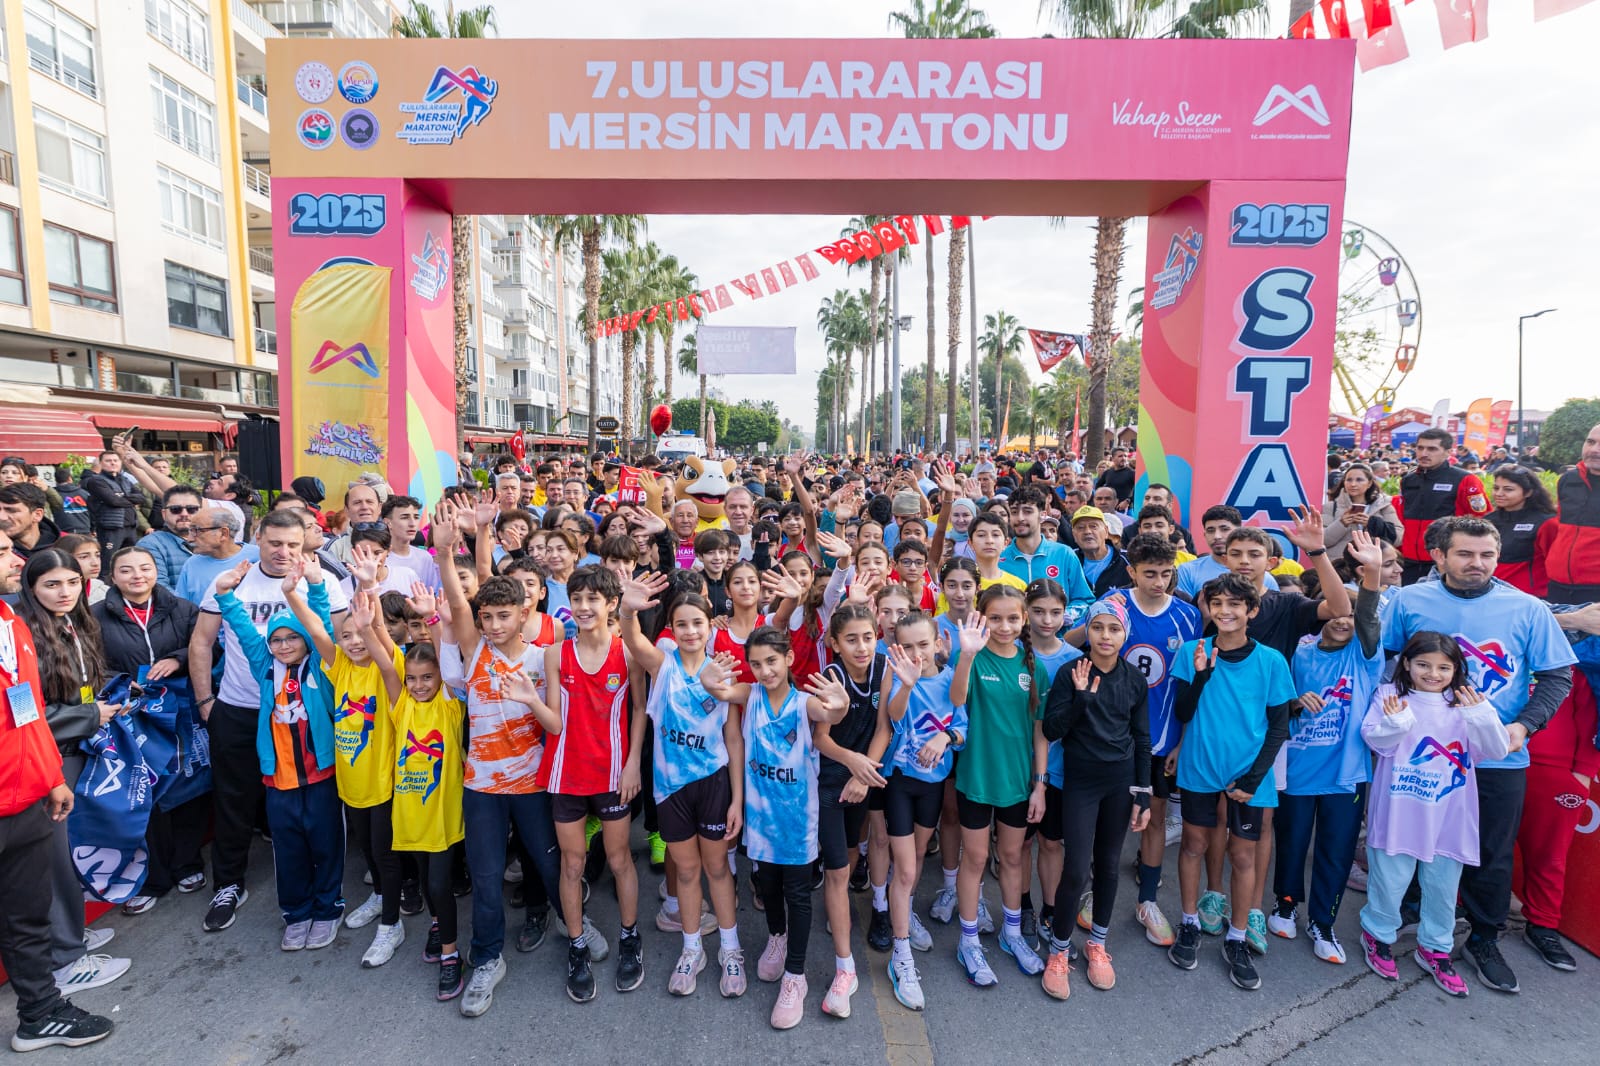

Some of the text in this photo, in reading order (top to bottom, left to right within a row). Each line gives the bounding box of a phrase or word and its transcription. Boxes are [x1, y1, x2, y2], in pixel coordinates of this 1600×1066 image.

[586, 61, 1042, 99] 7.ULUSLARARASI
[405, 124, 455, 132] MARATONU
[416, 111, 458, 122] MERSİN
[549, 100, 1068, 151] MERSİN MARATONU
[1112, 98, 1222, 138] Vahap Seçer
[291, 193, 386, 234] 2025
[1231, 204, 1330, 246] 2025
[1222, 267, 1316, 552] STA
[1138, 654, 1152, 678] 8
